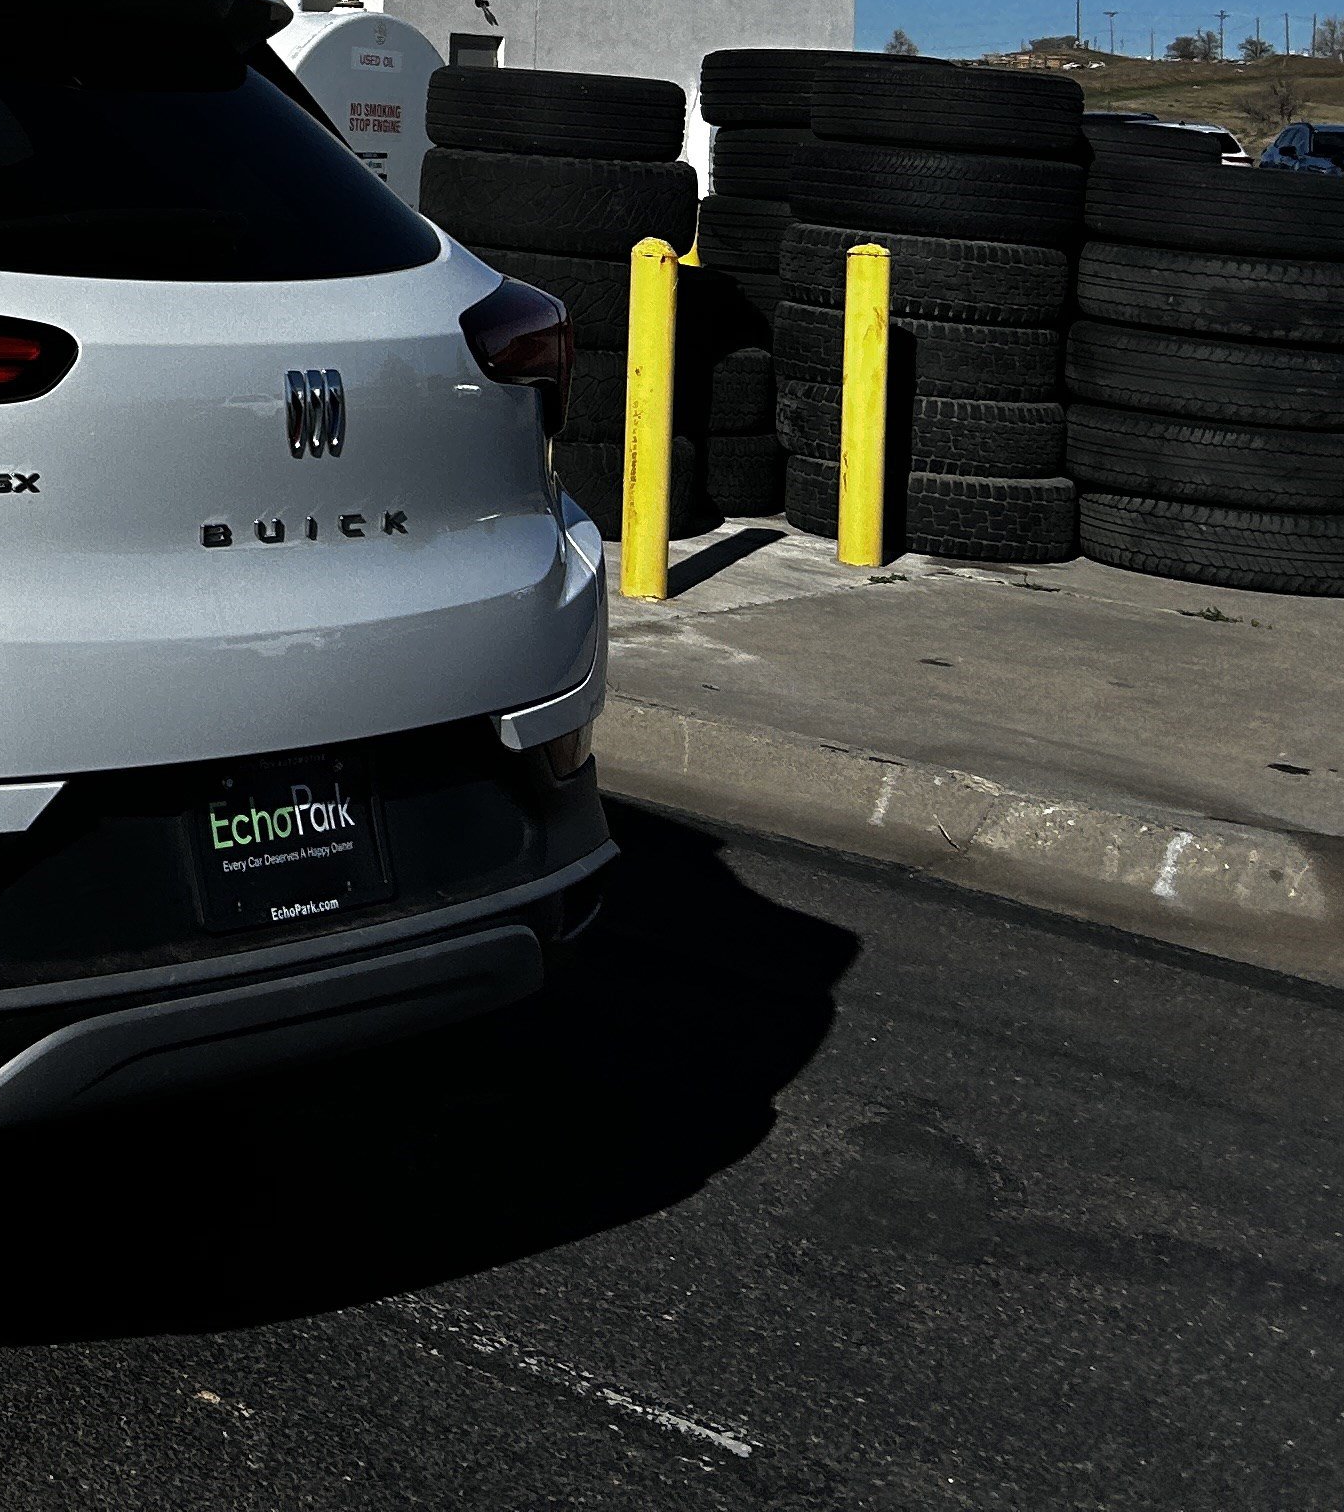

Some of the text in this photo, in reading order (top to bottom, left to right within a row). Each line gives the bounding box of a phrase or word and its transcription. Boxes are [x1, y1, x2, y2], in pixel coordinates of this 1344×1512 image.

[359, 54, 395, 68] USED OIL
[349, 102, 402, 119] NO SMOKING
[348, 117, 402, 134] STOP ENGINE
[199, 509, 409, 548] BUICK
[209, 783, 355, 849] EchoPark
[223, 840, 354, 873] Every Car Deserves A Happy Owner
[270, 898, 340, 921] EchoPark.com
